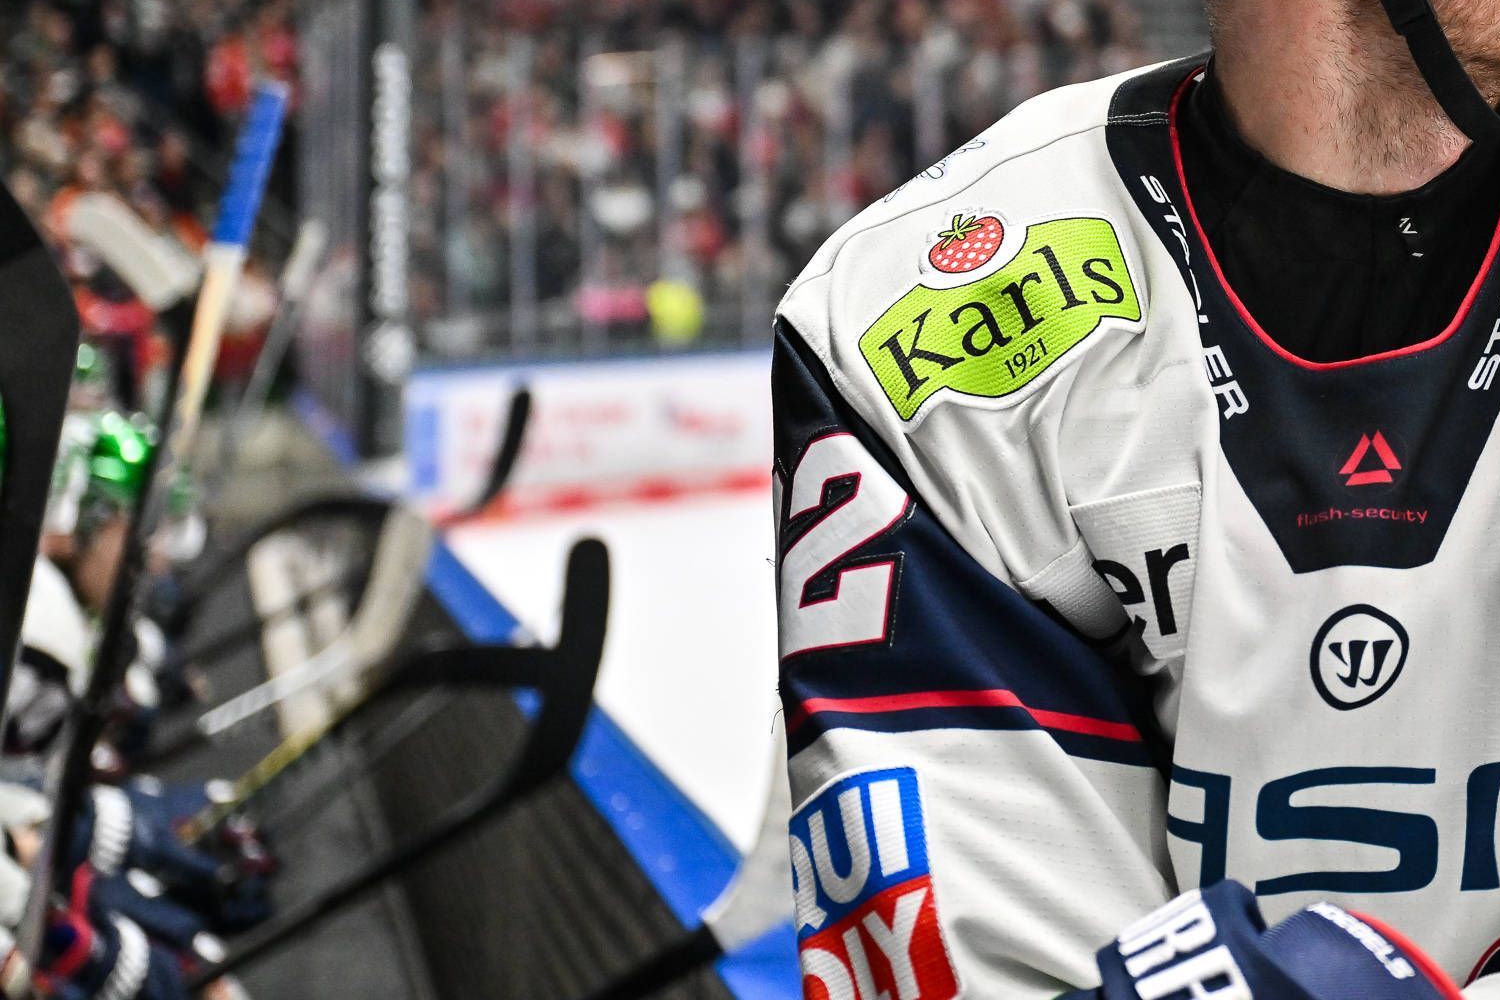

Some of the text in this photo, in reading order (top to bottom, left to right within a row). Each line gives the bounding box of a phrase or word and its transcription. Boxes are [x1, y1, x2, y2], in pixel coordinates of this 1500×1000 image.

[878, 244, 1125, 400] Karls
[1003, 337, 1048, 380] 1921
[1140, 175, 1250, 420] STAER
